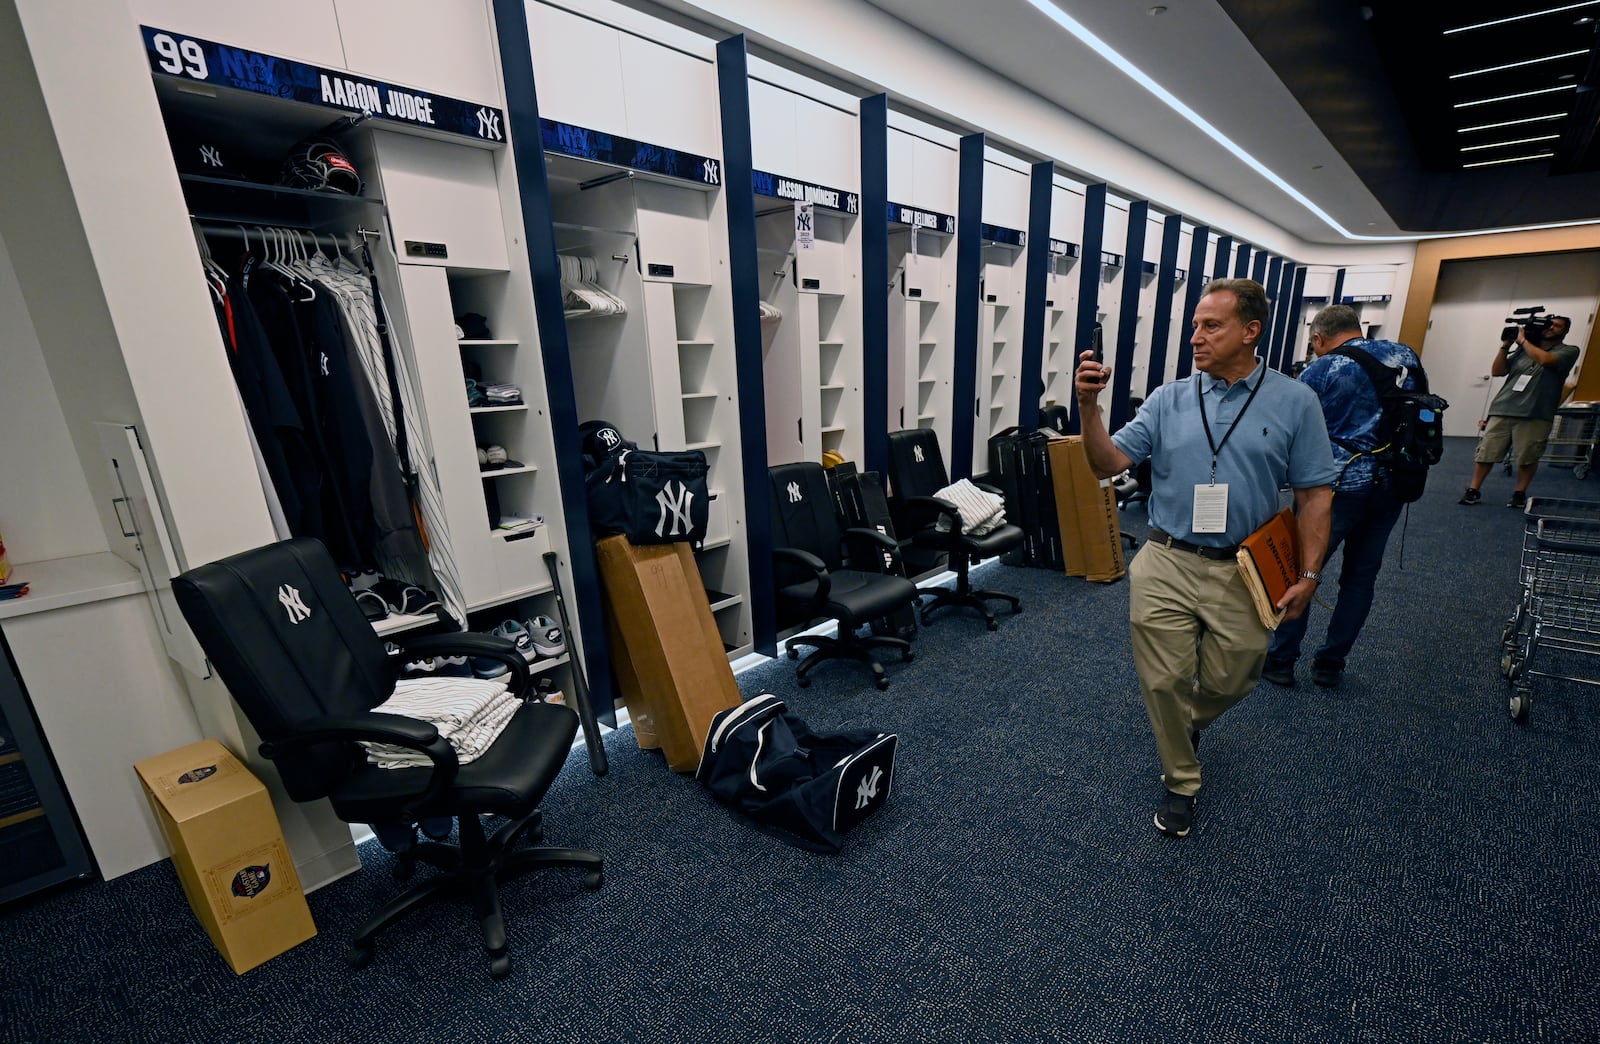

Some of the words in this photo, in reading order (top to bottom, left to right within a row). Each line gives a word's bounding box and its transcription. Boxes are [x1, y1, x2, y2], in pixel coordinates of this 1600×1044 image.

[153, 33, 209, 80] 99
[319, 73, 383, 114] AARON
[385, 89, 436, 124] JUDGE
[475, 106, 503, 141] NY
[702, 158, 719, 185] NY
[777, 179, 804, 202] JASSON
[797, 213, 811, 231] NY
[655, 479, 695, 538] NY
[278, 583, 312, 625] NY
[855, 764, 883, 810] NY
